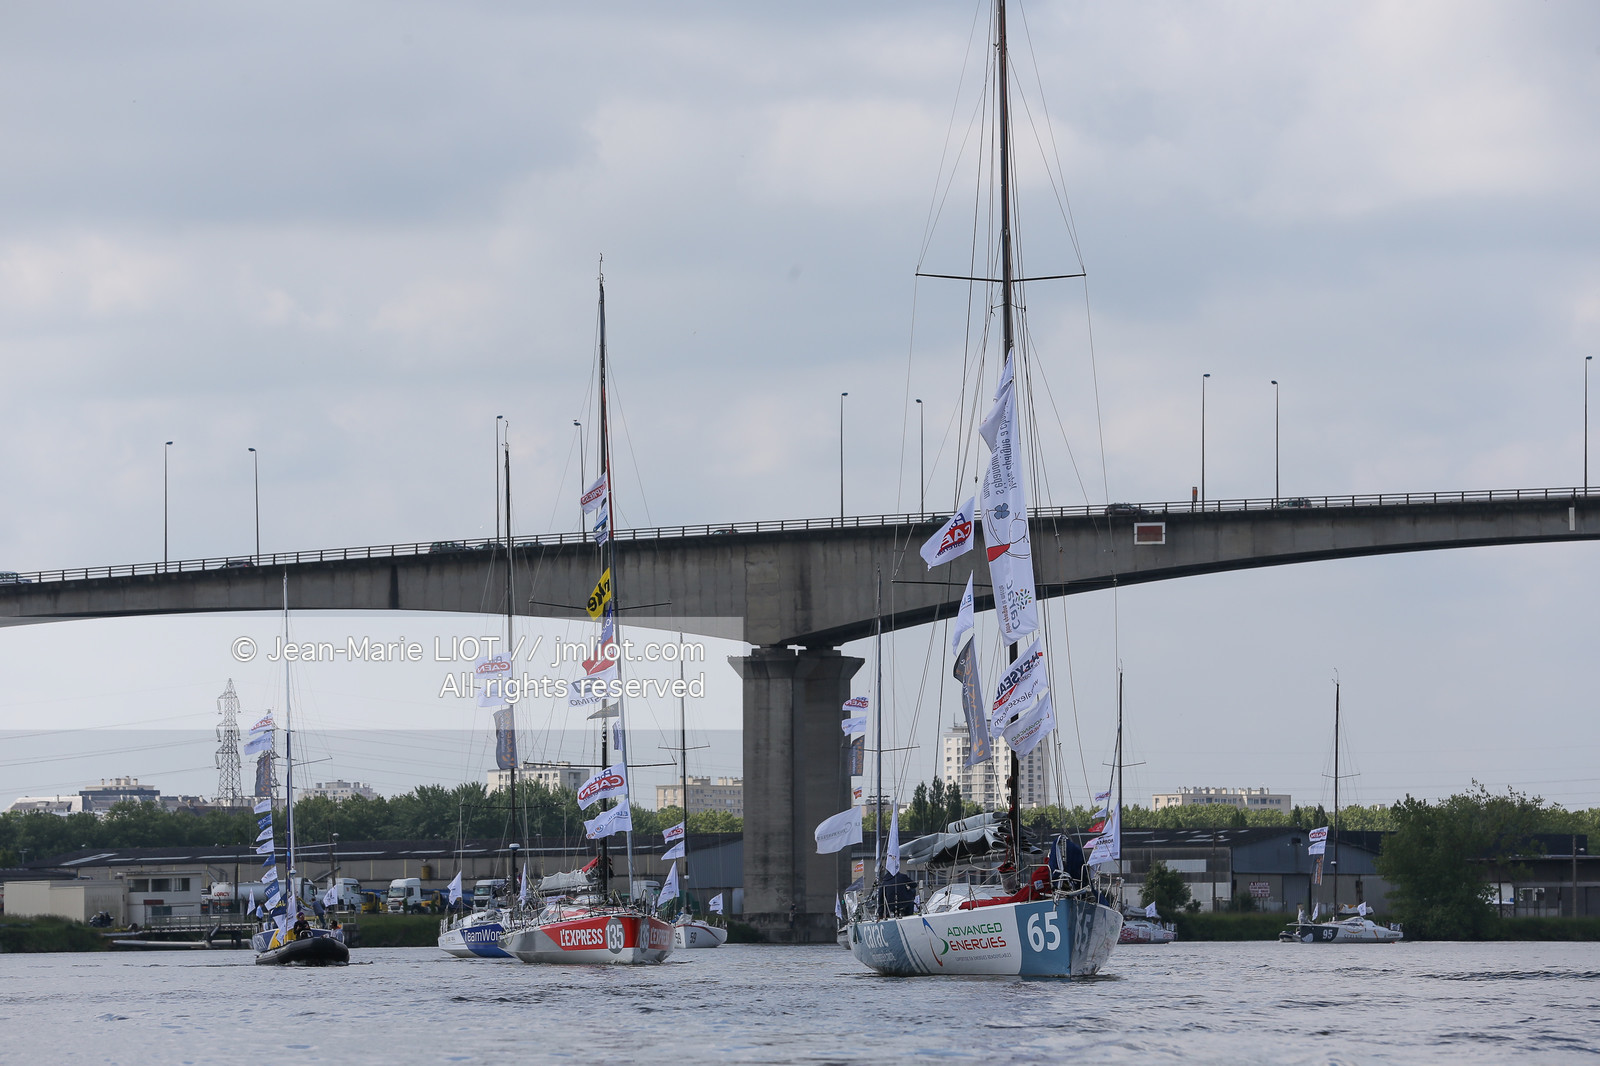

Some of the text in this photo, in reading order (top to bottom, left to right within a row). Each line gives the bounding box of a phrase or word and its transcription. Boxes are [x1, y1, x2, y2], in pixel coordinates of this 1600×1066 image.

[464, 929, 500, 942] TeamWor
[606, 924, 624, 949] 135
[947, 921, 1002, 937] ADVANCED
[1027, 911, 1061, 953] 65
[1322, 929, 1333, 939] 95
[560, 928, 604, 947] L'EXPRESS
[690, 932, 697, 944] 59
[949, 936, 1007, 951] ENERGIES
